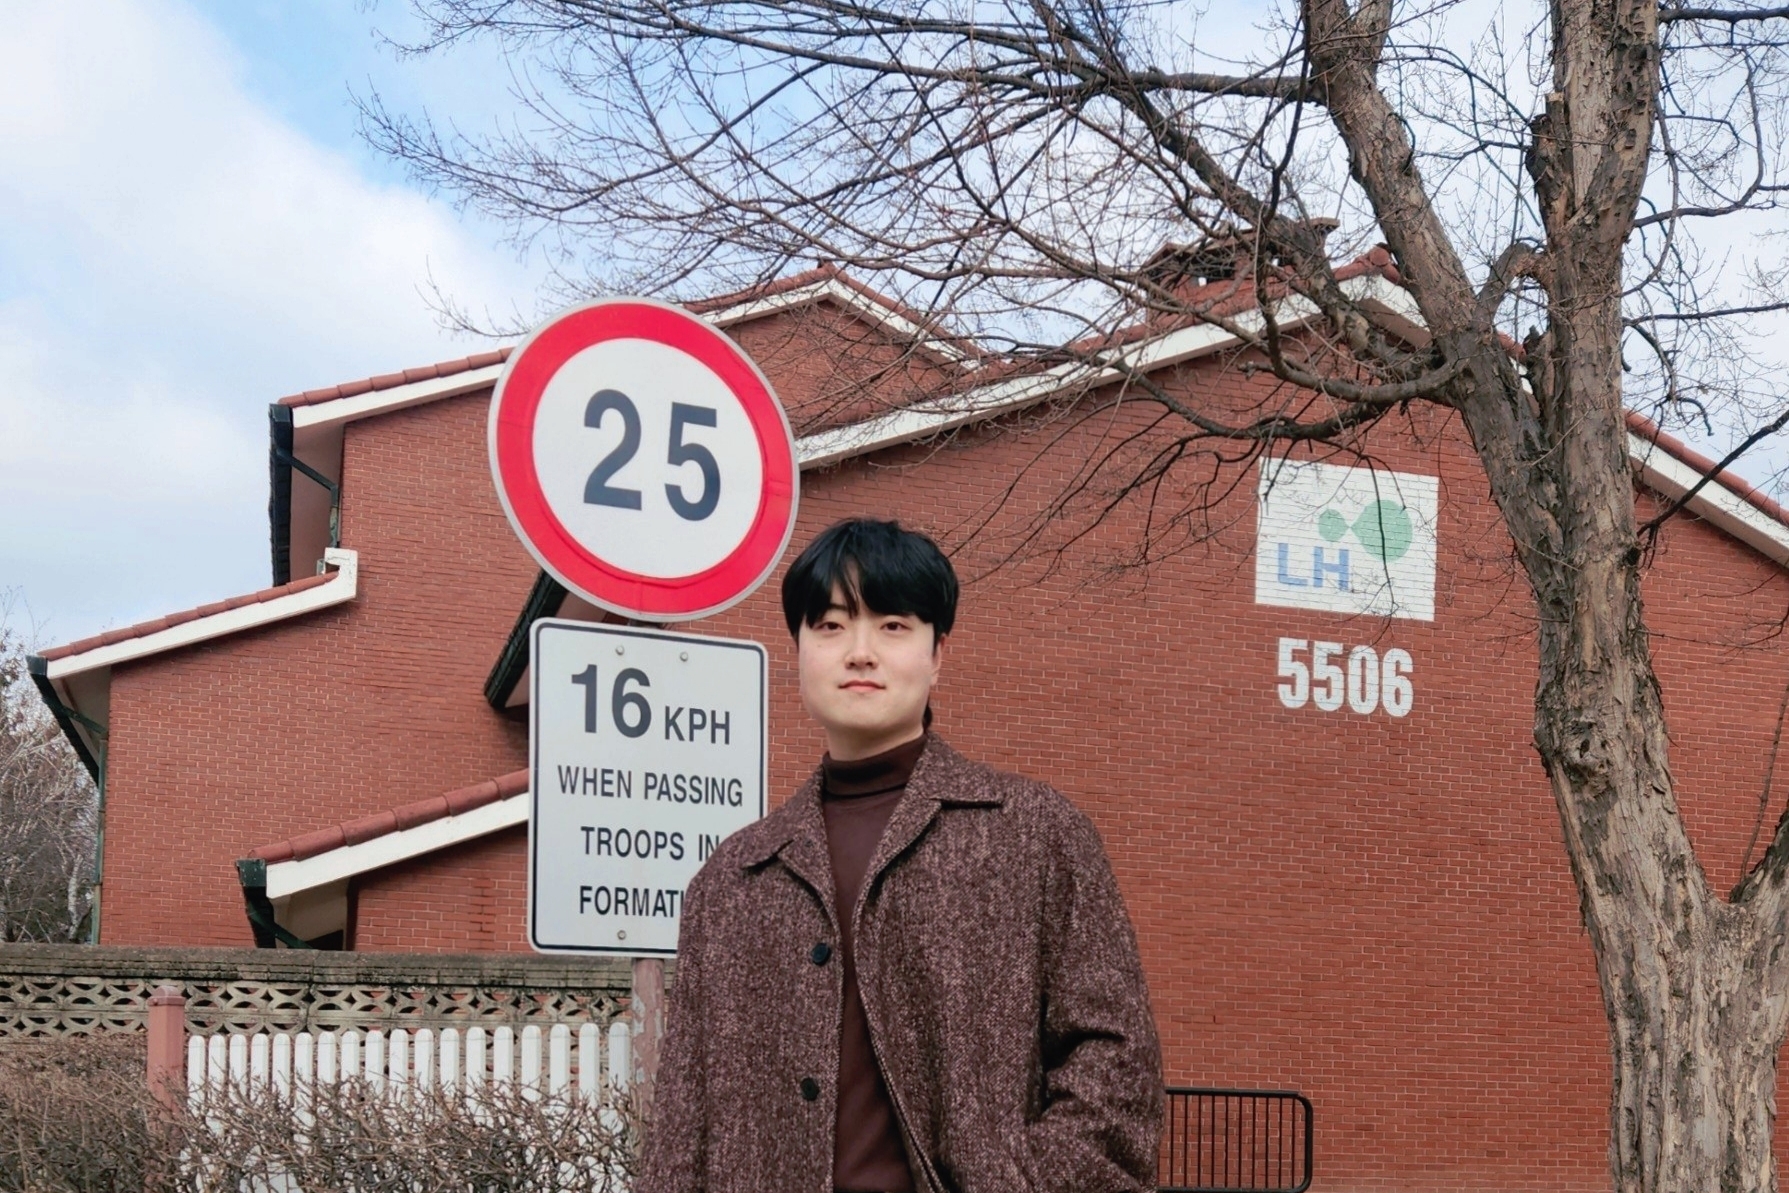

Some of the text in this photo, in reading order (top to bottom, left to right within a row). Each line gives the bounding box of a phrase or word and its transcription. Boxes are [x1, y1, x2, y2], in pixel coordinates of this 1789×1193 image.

[583, 388, 721, 522] 25
[1277, 542, 1350, 591] LH
[571, 664, 730, 745] 16 KPH
[1278, 637, 1413, 717] 5506
[558, 765, 743, 807] WHEN PASSING
[580, 826, 685, 861] TROOPS
